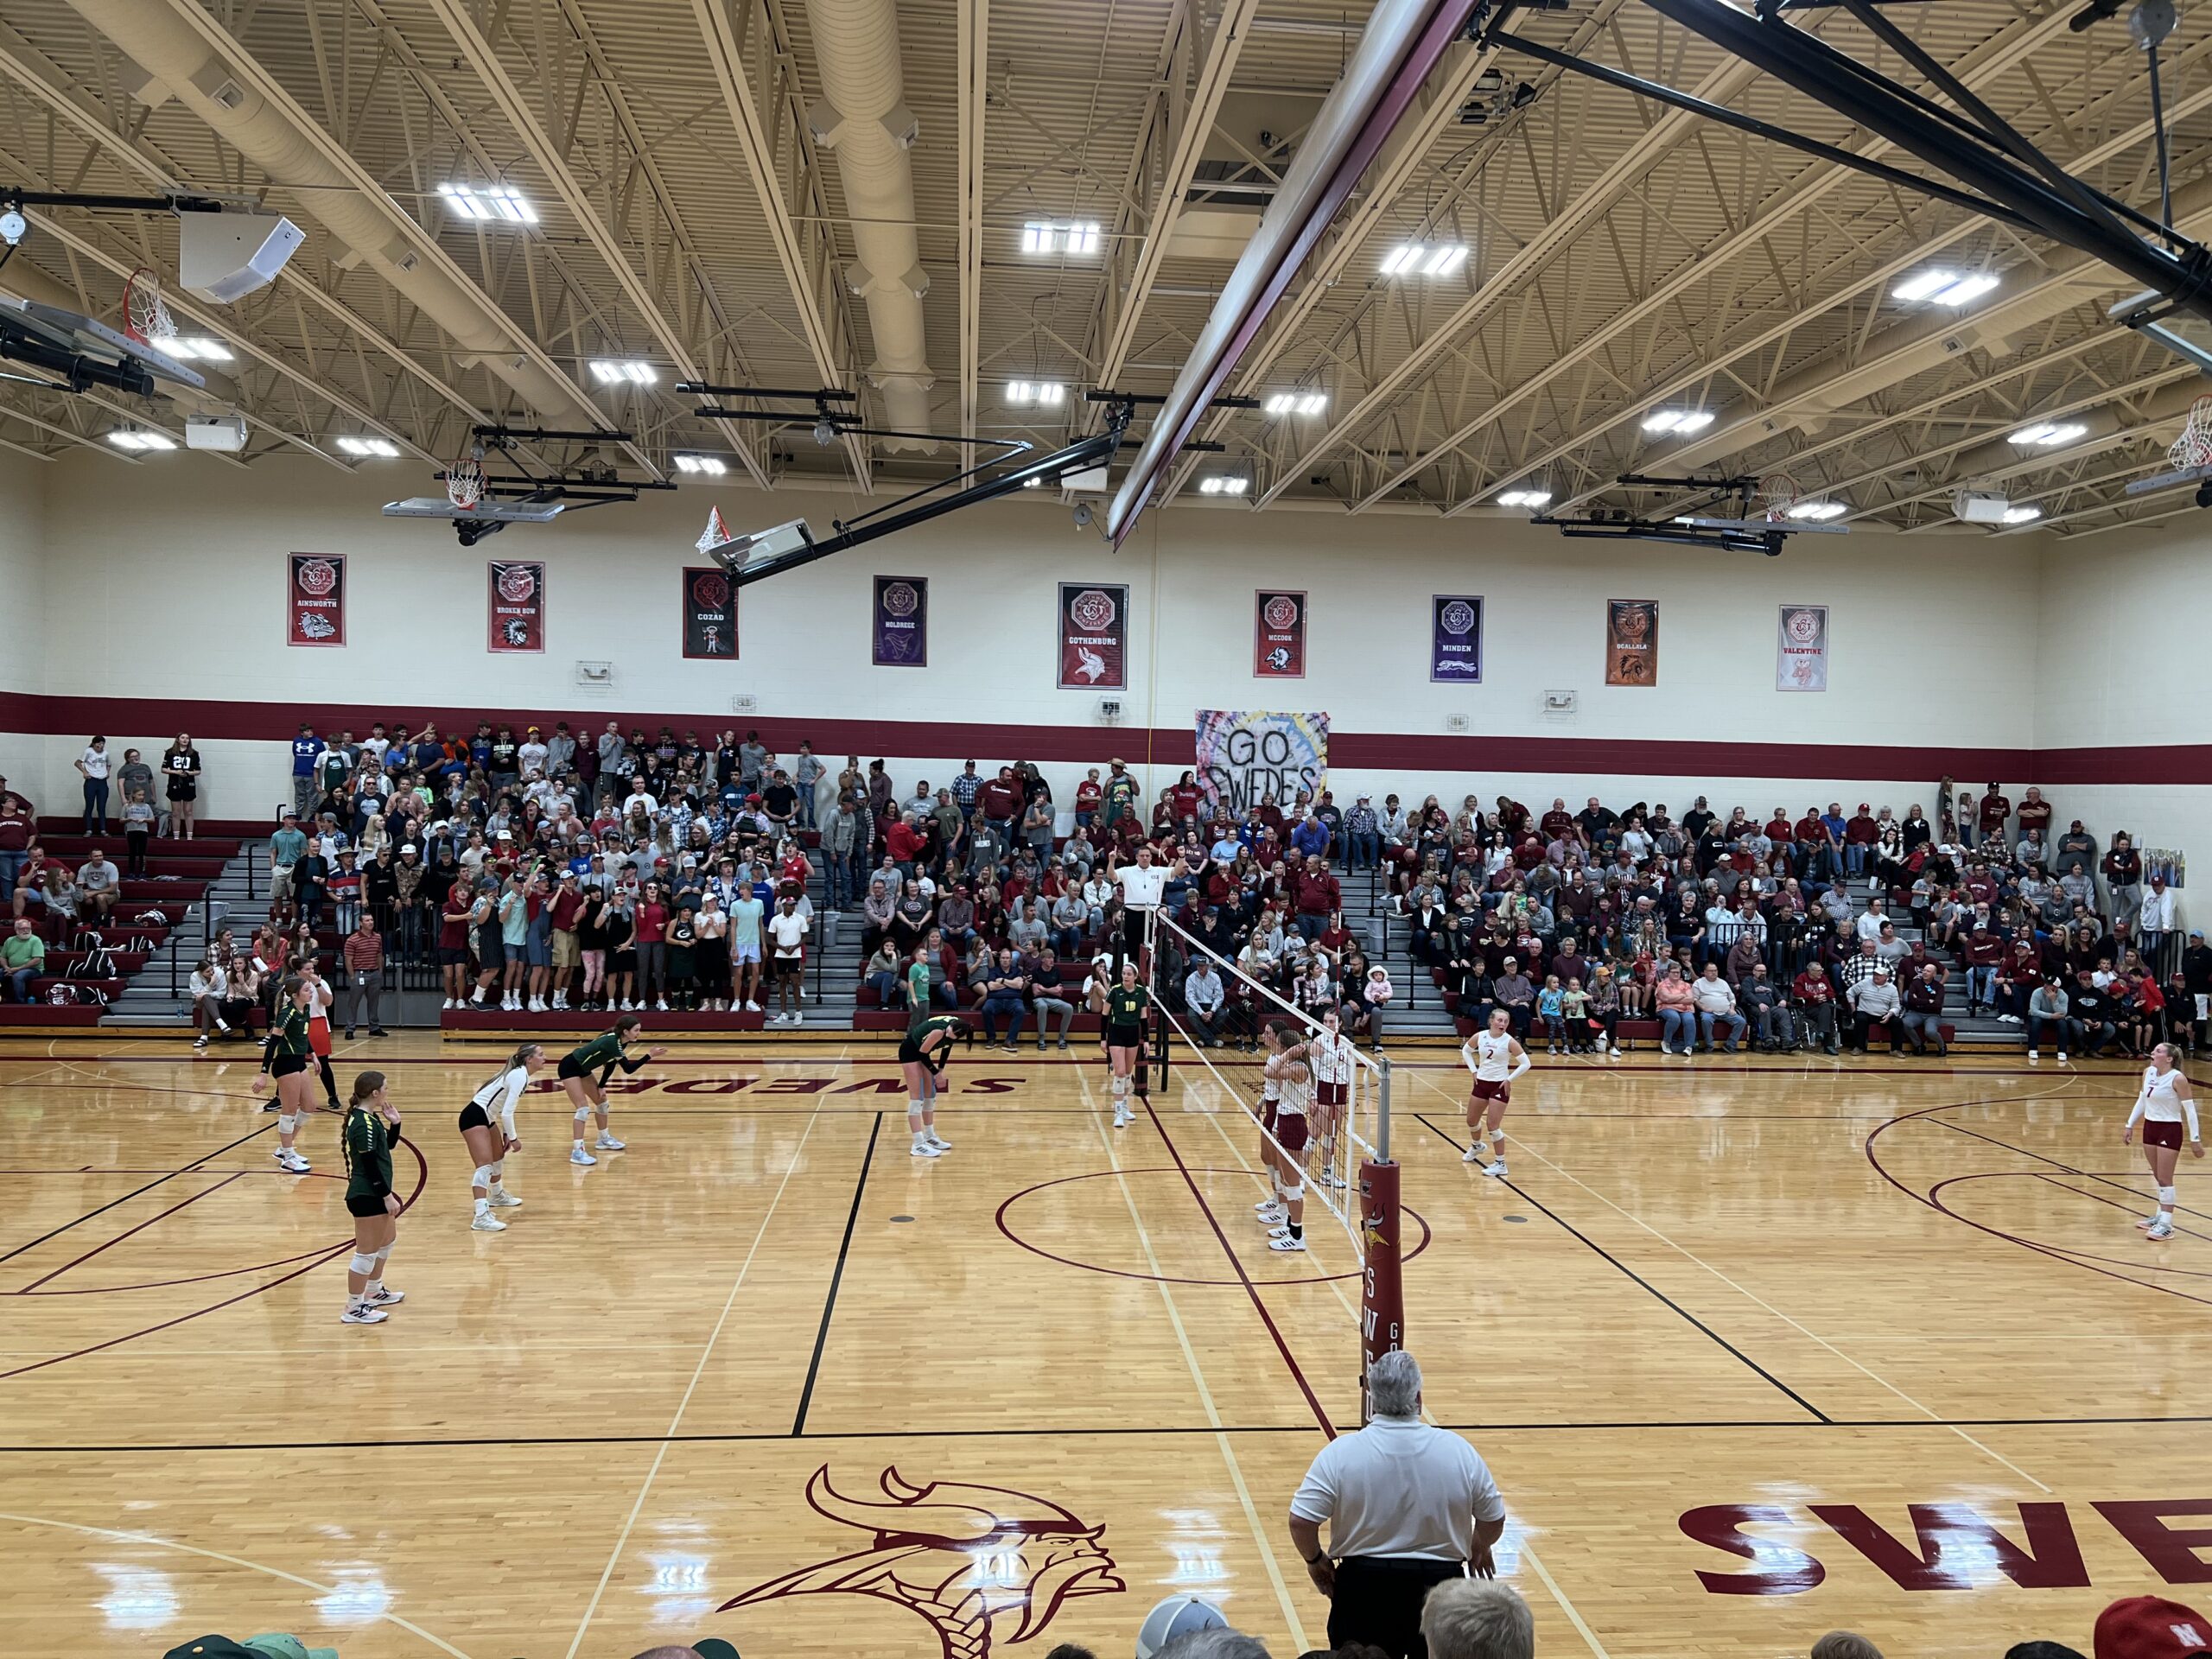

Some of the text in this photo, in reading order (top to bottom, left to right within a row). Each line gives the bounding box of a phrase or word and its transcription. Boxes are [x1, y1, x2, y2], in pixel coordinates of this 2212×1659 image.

[1069, 636, 1116, 646] GOTHENBURG
[1442, 644, 1471, 652] MINDEN
[1228, 729, 1289, 766] GO
[173, 755, 191, 770] 20
[1205, 766, 1316, 810] SWEDES
[1485, 1049, 1494, 1059] 2
[2146, 1086, 2154, 1098] 7
[2170, 1624, 2206, 1648] N
